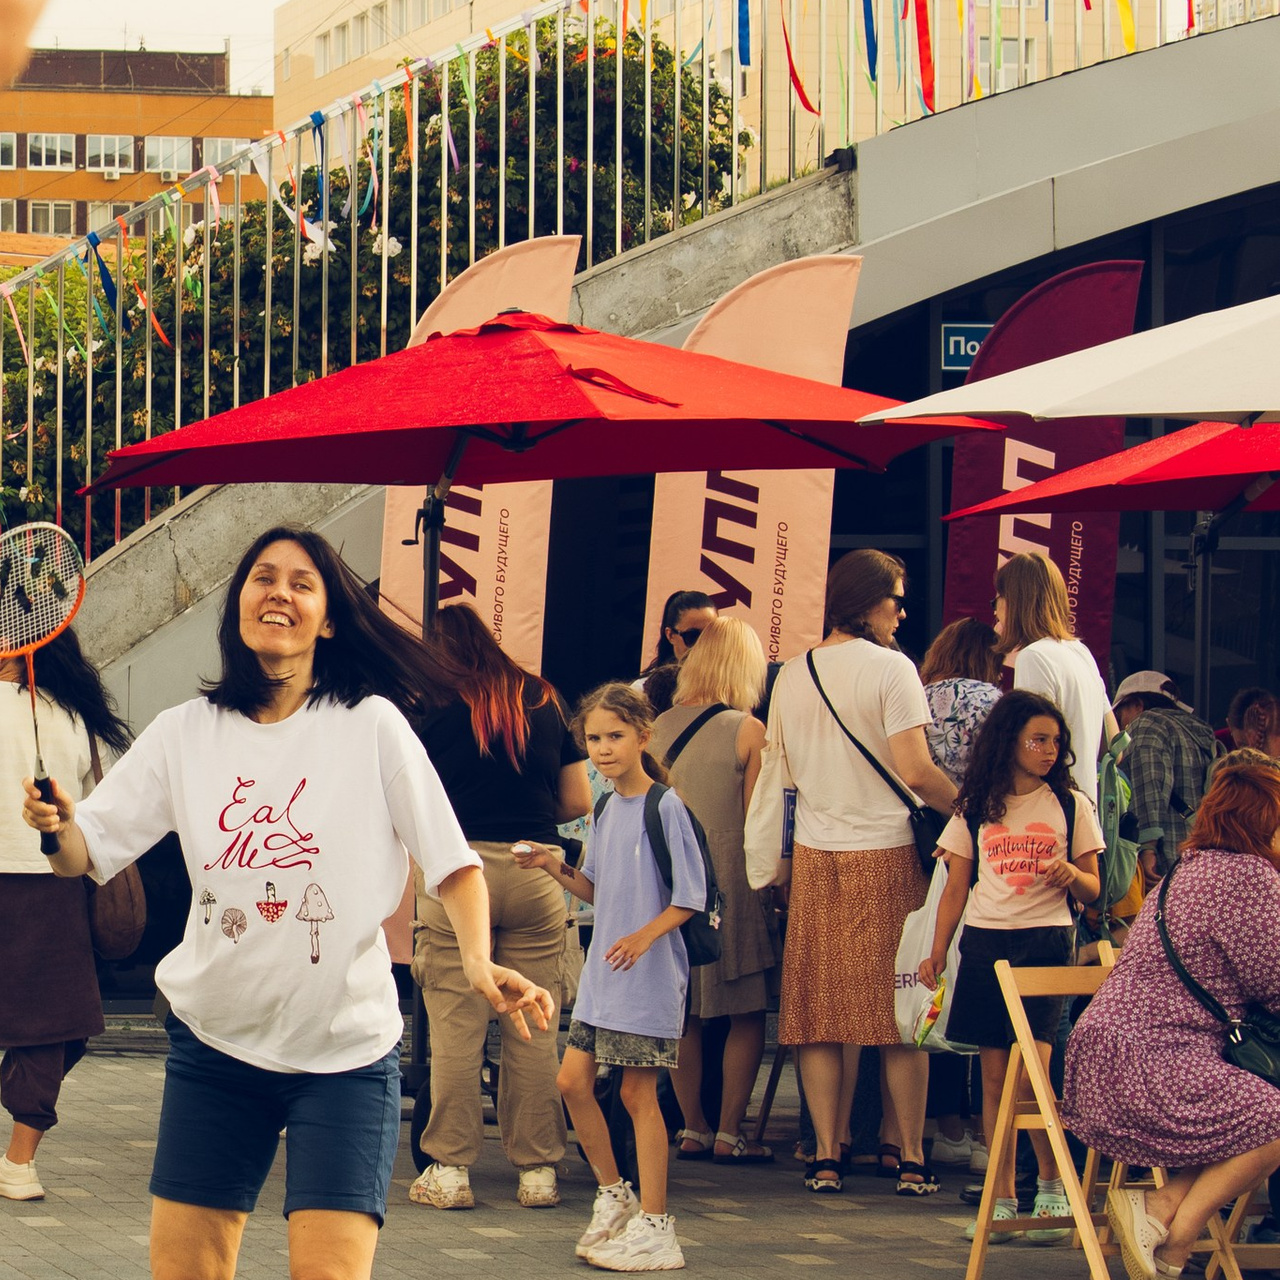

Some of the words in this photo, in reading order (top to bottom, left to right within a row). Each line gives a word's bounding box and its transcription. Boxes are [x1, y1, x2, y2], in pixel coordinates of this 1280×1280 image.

[949, 336, 984, 355] По
[495, 508, 510, 583] БУДУЩЕГО
[773, 521, 789, 595] БУДУЩЕГО
[1067, 521, 1084, 595] БУДУЩЕГО
[987, 835, 1058, 859] unlimited
[1000, 857, 1040, 877] heart
